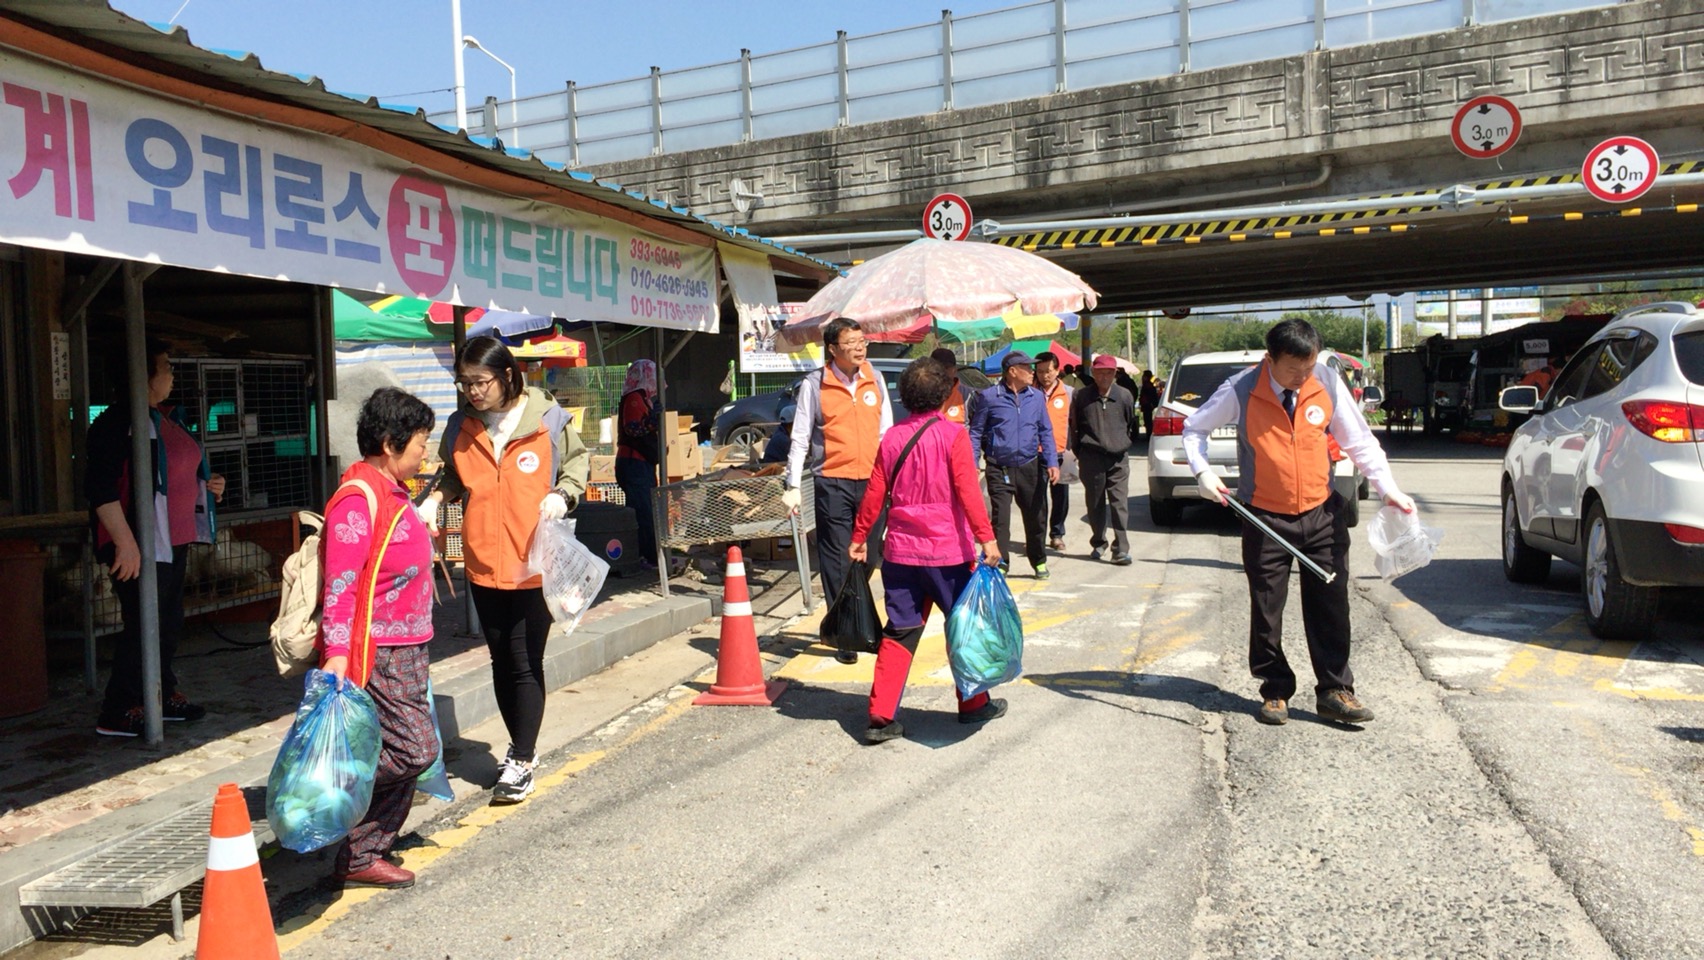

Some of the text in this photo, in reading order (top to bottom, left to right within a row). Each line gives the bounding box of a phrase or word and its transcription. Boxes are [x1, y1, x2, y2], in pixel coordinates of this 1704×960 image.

[1472, 125, 1508, 141] 3.0 m
[2, 82, 95, 221] 계
[125, 118, 381, 263] 오리로스
[1596, 157, 1643, 182] 3.0m
[932, 210, 963, 231] 3.0m
[630, 238, 682, 269] 393-6945
